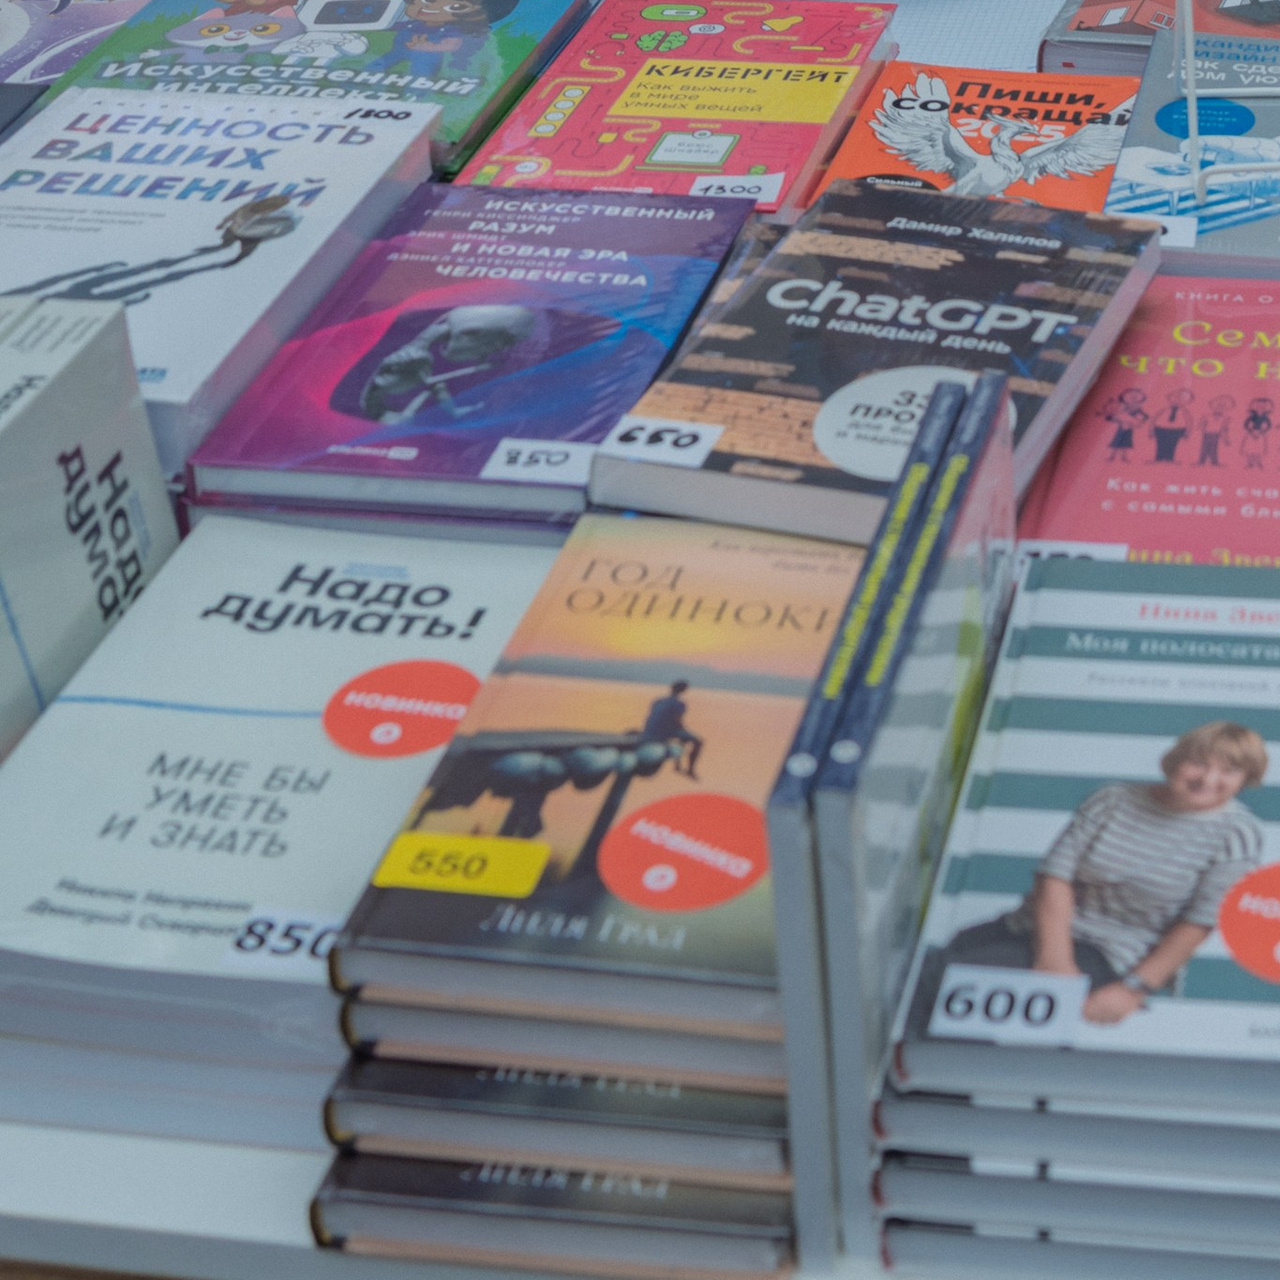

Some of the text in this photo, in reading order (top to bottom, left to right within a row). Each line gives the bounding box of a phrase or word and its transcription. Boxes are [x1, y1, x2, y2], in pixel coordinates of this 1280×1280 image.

[101, 61, 482, 95] Искусственный
[637, 82, 757, 94] Как выжить
[645, 64, 850, 83] КИБЕРГЕЙТ
[621, 100, 764, 112] умных вещей
[956, 81, 1106, 108] Пиши,
[64, 113, 375, 146] ЦЕННОСТЬ
[31, 140, 281, 172] ВАШИХ
[0, 169, 328, 207] РЕШЕНИЙ
[484, 199, 716, 222] ИСКУССТВЕННЫЙ
[468, 220, 557, 234] РАЗУМ
[886, 217, 1062, 249] Дамир Халилов
[451, 243, 629, 262] И НОВАЯ ЭРА
[435, 264, 648, 287] ЧЕЛОВЕЧЕСТВА
[766, 279, 1079, 344] ChatGPT
[1174, 291, 1244, 304] КНИГА
[786, 314, 1012, 355] на каждый день
[1117, 354, 1225, 378] что
[1107, 477, 1150, 493] Как
[1166, 483, 1222, 497] жить
[276, 563, 451, 609] Надо
[580, 558, 684, 591] ГОД
[201, 593, 487, 641] думать!
[147, 752, 332, 794] МНЕ БЫ
[145, 785, 289, 825] УМЕТЬ
[98, 813, 289, 858] И ЗНАТЬ
[408, 849, 488, 880] 550
[942, 982, 1057, 1027] 600
